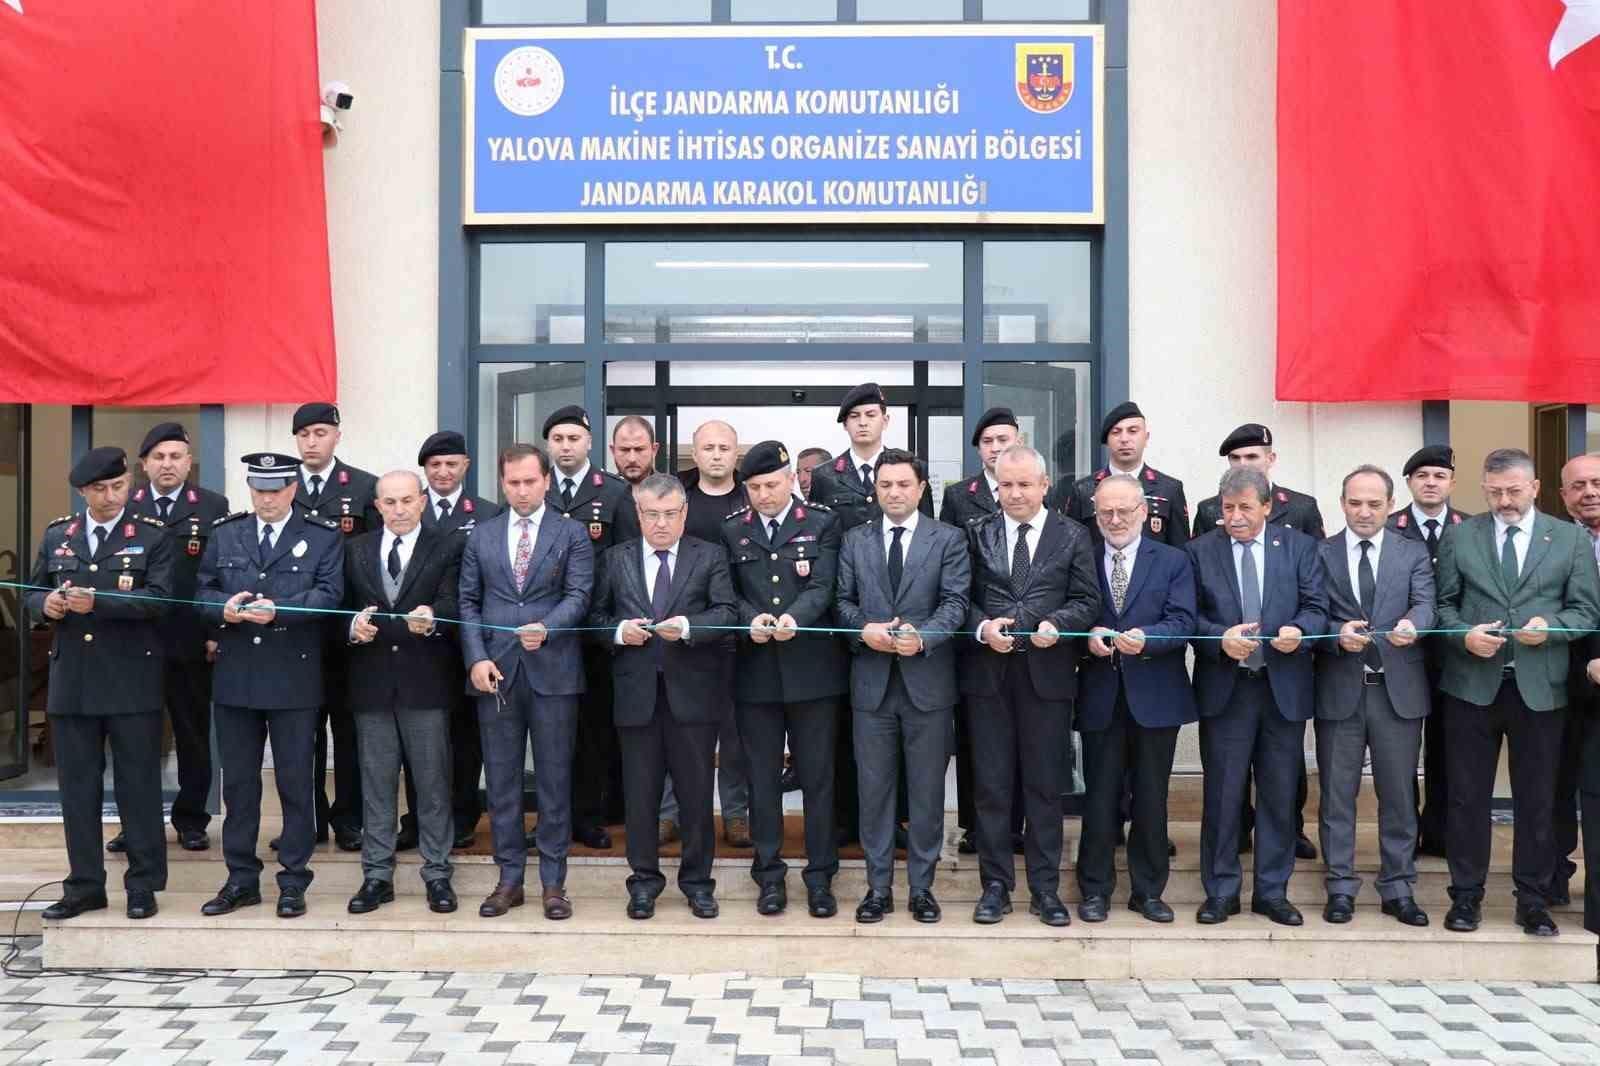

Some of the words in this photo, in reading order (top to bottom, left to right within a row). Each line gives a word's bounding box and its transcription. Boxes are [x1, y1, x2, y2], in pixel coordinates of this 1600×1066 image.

[765, 45, 803, 70] T.C.
[610, 85, 657, 122] İLÇE
[663, 90, 790, 115] JANDARMA
[796, 83, 959, 115] KOMUTANLIĞI
[488, 136, 575, 162] YALOVA
[580, 130, 671, 161] MAKİNE
[678, 129, 765, 161] İHTİSAS
[771, 129, 890, 161] ORGANİZE
[896, 128, 977, 160] SANAYİ
[984, 128, 1082, 160] BÖLGESİ
[581, 181, 707, 206] JANDARMA
[713, 180, 818, 205] KARAKOL
